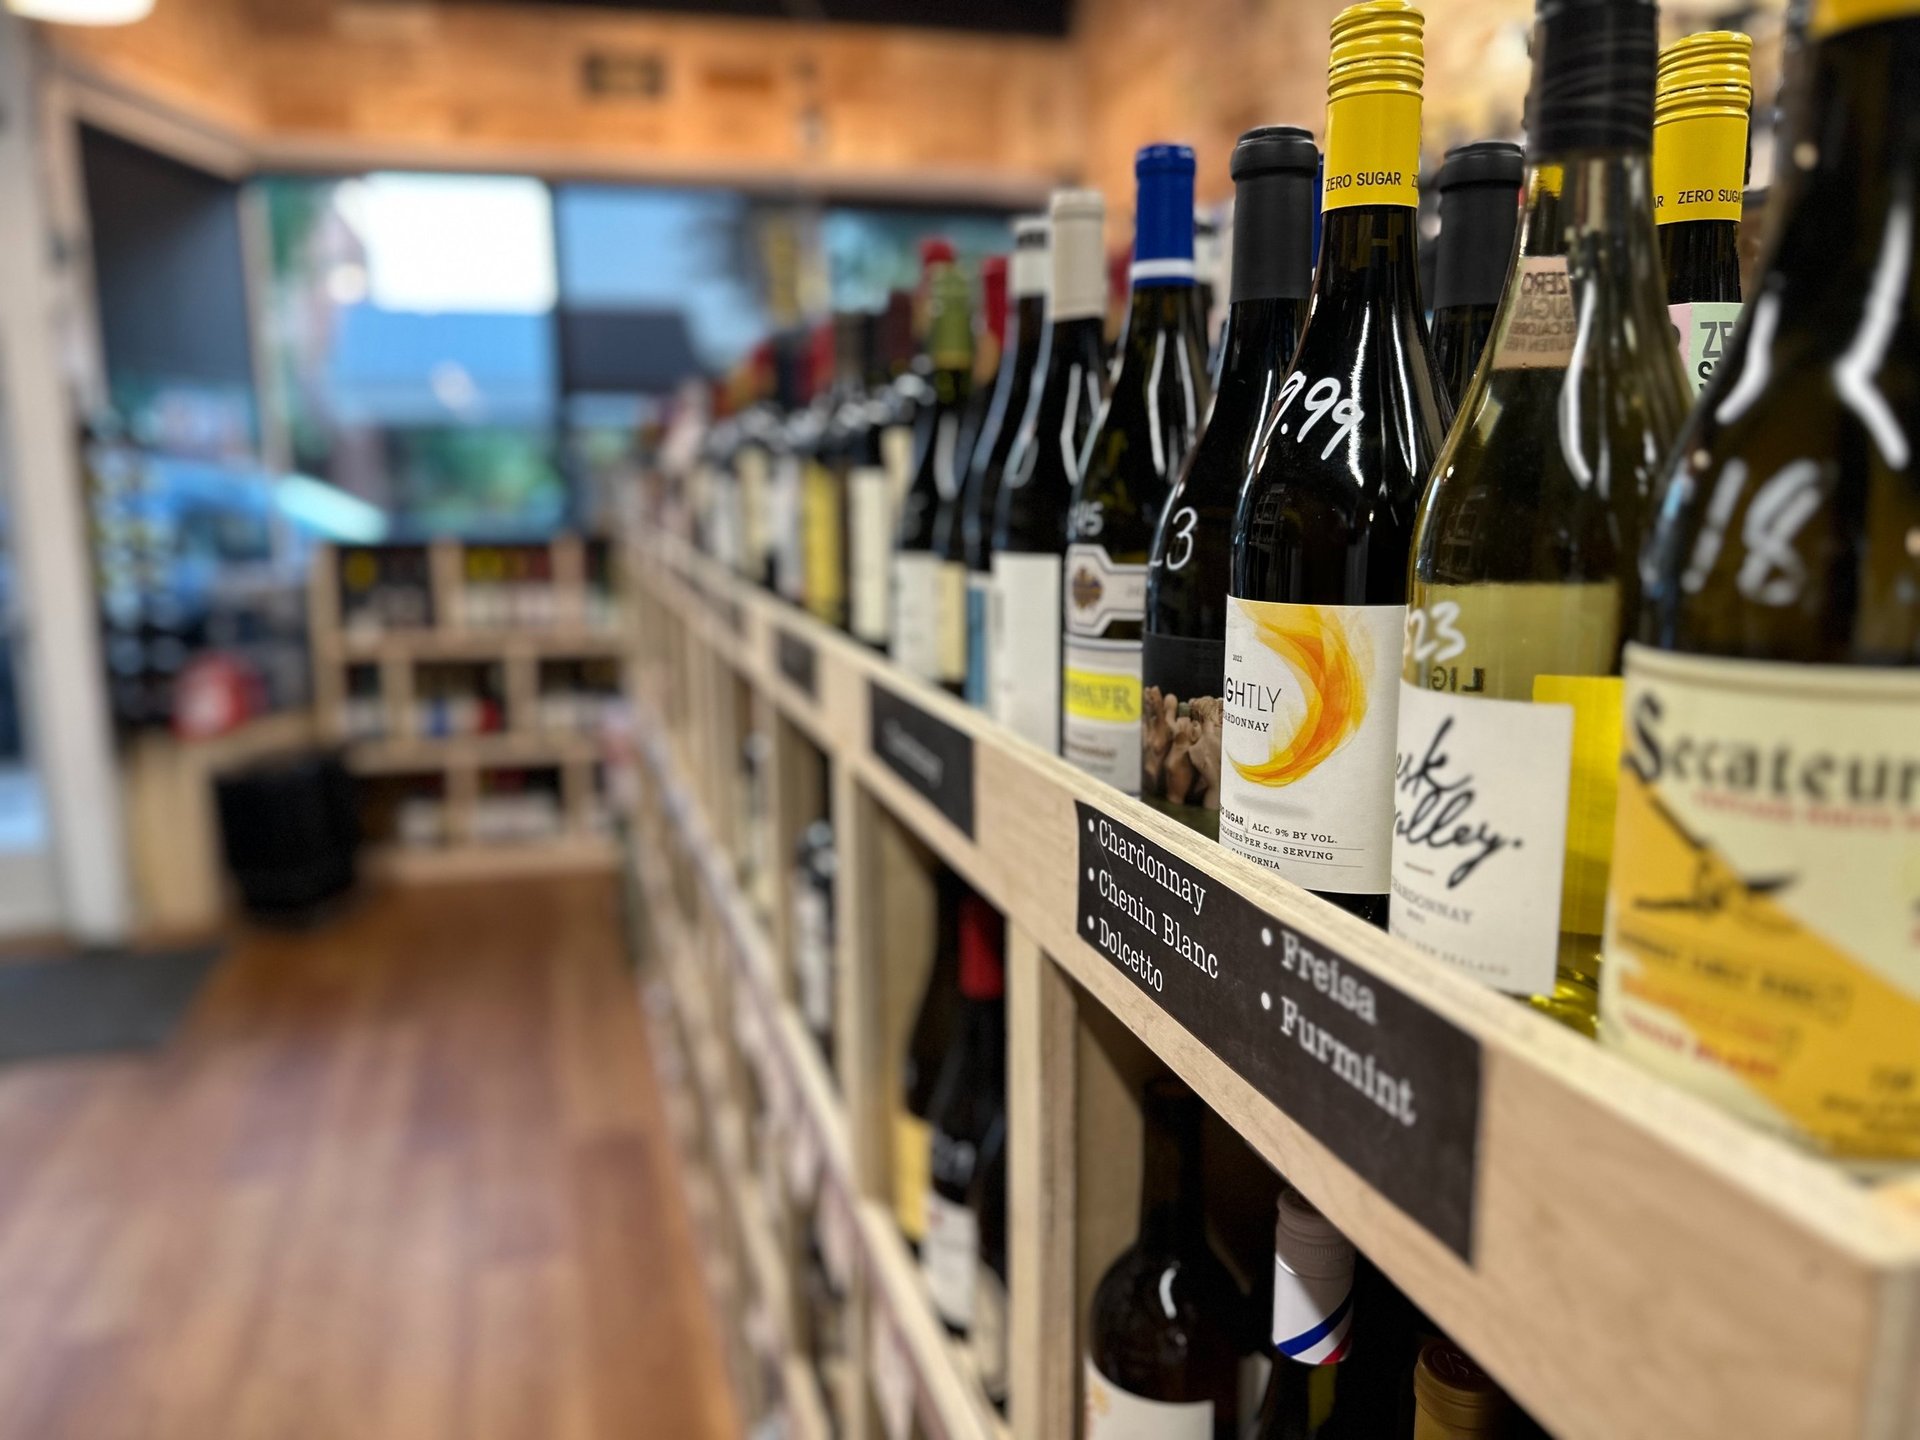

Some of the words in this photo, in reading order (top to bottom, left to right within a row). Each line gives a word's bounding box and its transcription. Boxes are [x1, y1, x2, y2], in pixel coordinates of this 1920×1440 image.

[1325, 174, 1352, 192] ZERO
[1356, 171, 1402, 186] SUGAR
[1677, 189, 1714, 205] ZERO
[1222, 710, 1269, 732] ARDONNAY
[1225, 809, 1244, 826] SUGAR
[1252, 822, 1272, 835] ALC.
[1275, 828, 1289, 838] 9%
[1292, 831, 1307, 840] BY
[1311, 833, 1338, 844] VOL.
[1245, 835, 1261, 848] PER
[1263, 842, 1280, 853] 5oz.
[1283, 846, 1334, 861] SERVING
[1099, 818, 1207, 916] Chardonnay
[1099, 868, 1157, 935] Chenin
[1162, 912, 1219, 979] Blanc
[1099, 916, 1163, 992] Dolcetto
[1280, 929, 1378, 1026] Freisa
[1280, 995, 1417, 1127] Furmint
